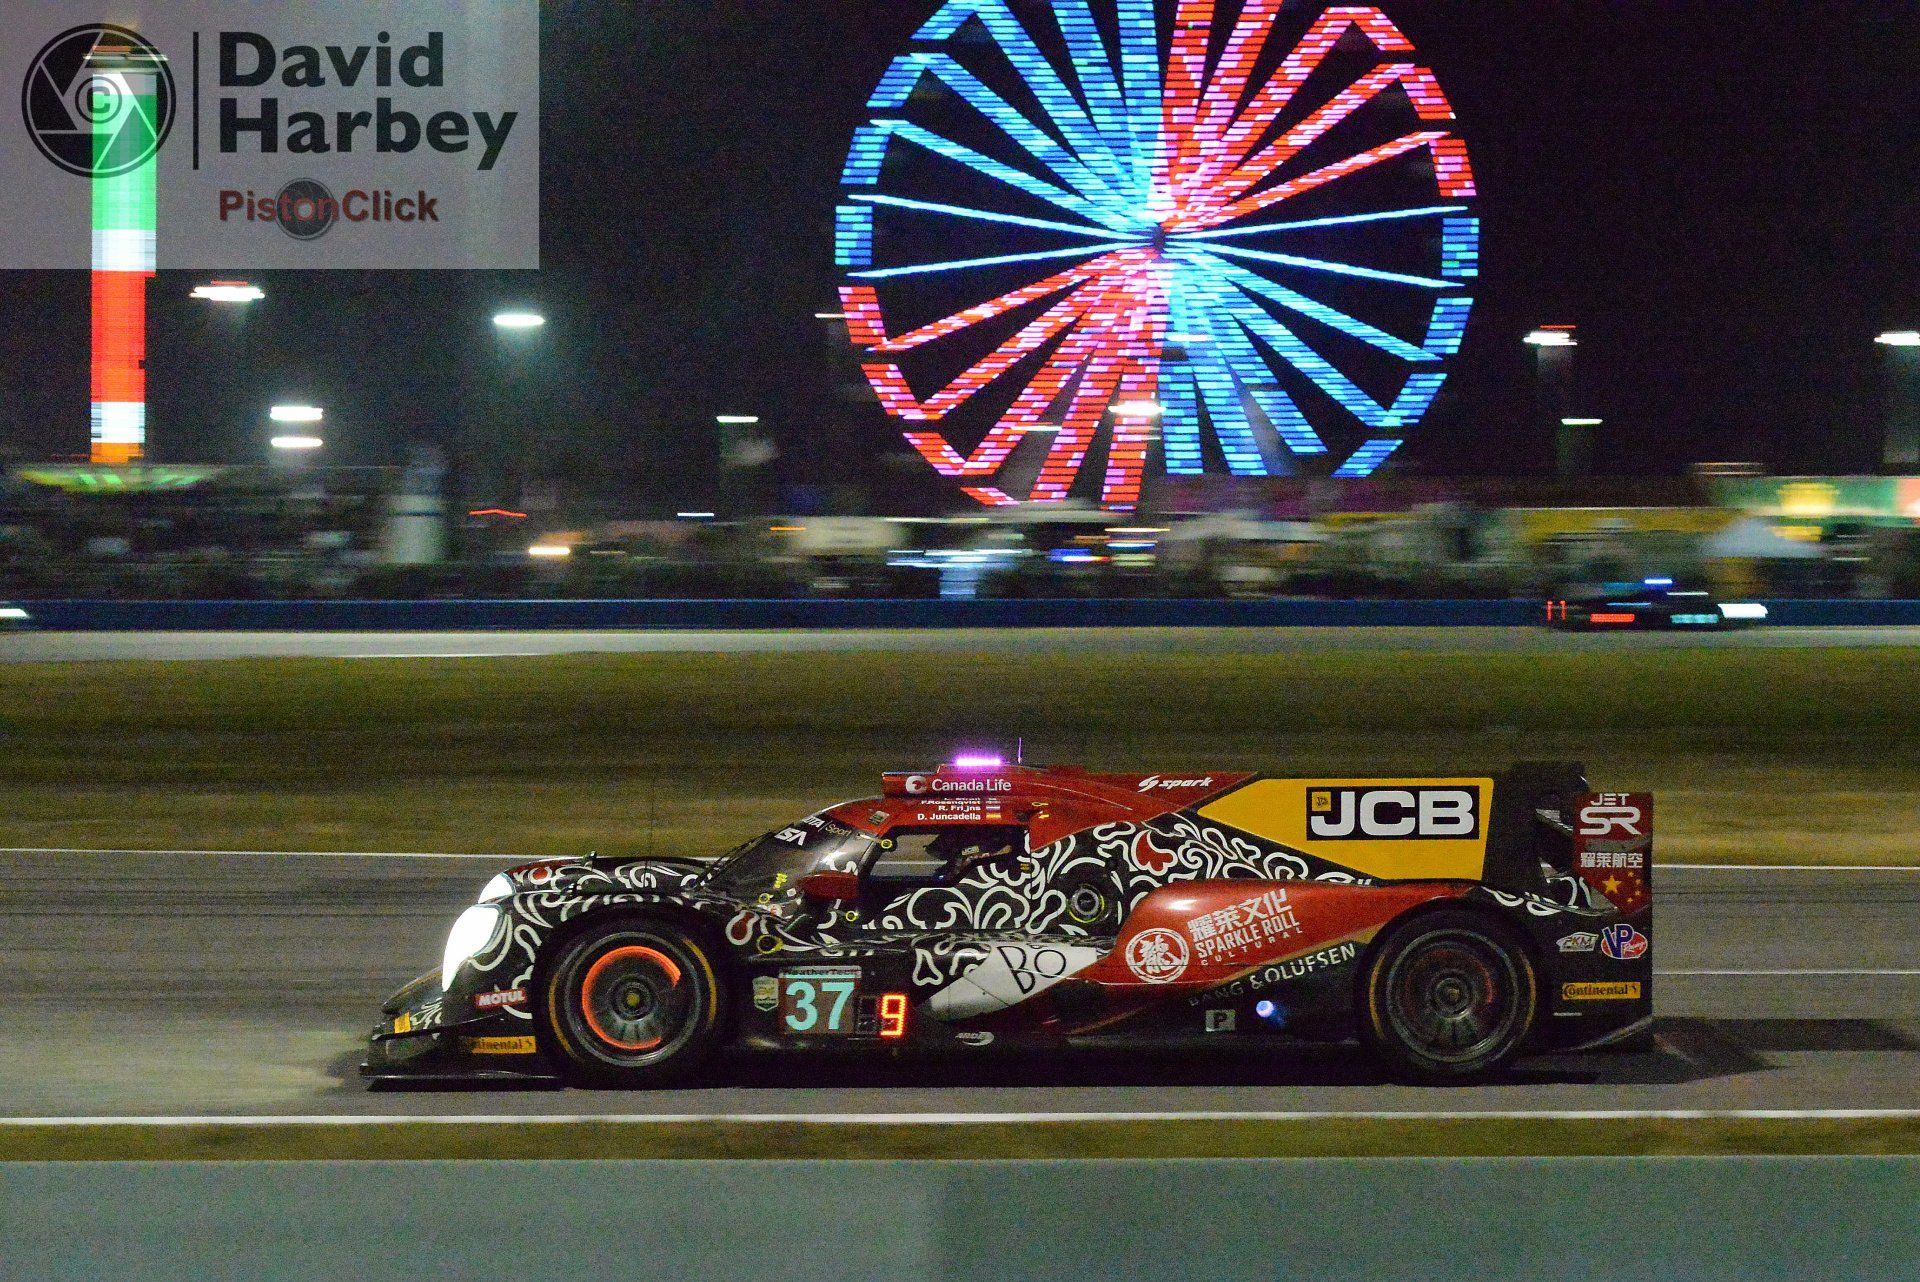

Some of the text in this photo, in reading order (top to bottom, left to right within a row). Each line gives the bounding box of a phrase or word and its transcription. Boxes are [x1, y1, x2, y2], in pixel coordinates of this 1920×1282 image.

[931, 778, 1012, 791] Canada Life
[1159, 777, 1213, 789] spark
[1311, 791, 1474, 836] JCB
[1590, 793, 1630, 805] JET
[929, 812, 981, 820] Juncadella
[1580, 806, 1641, 835] SR
[1194, 910, 1300, 960] SPARKLE ROLL
[1200, 925, 1303, 966] CULTURAL
[1602, 924, 1634, 958] VP
[1250, 974, 1264, 990] &
[1264, 943, 1356, 983] OLUFSEN
[479, 990, 526, 1006] MOTUL
[785, 982, 855, 1031] 37
[1564, 984, 1628, 998] Continental
[880, 994, 907, 1037] 9
